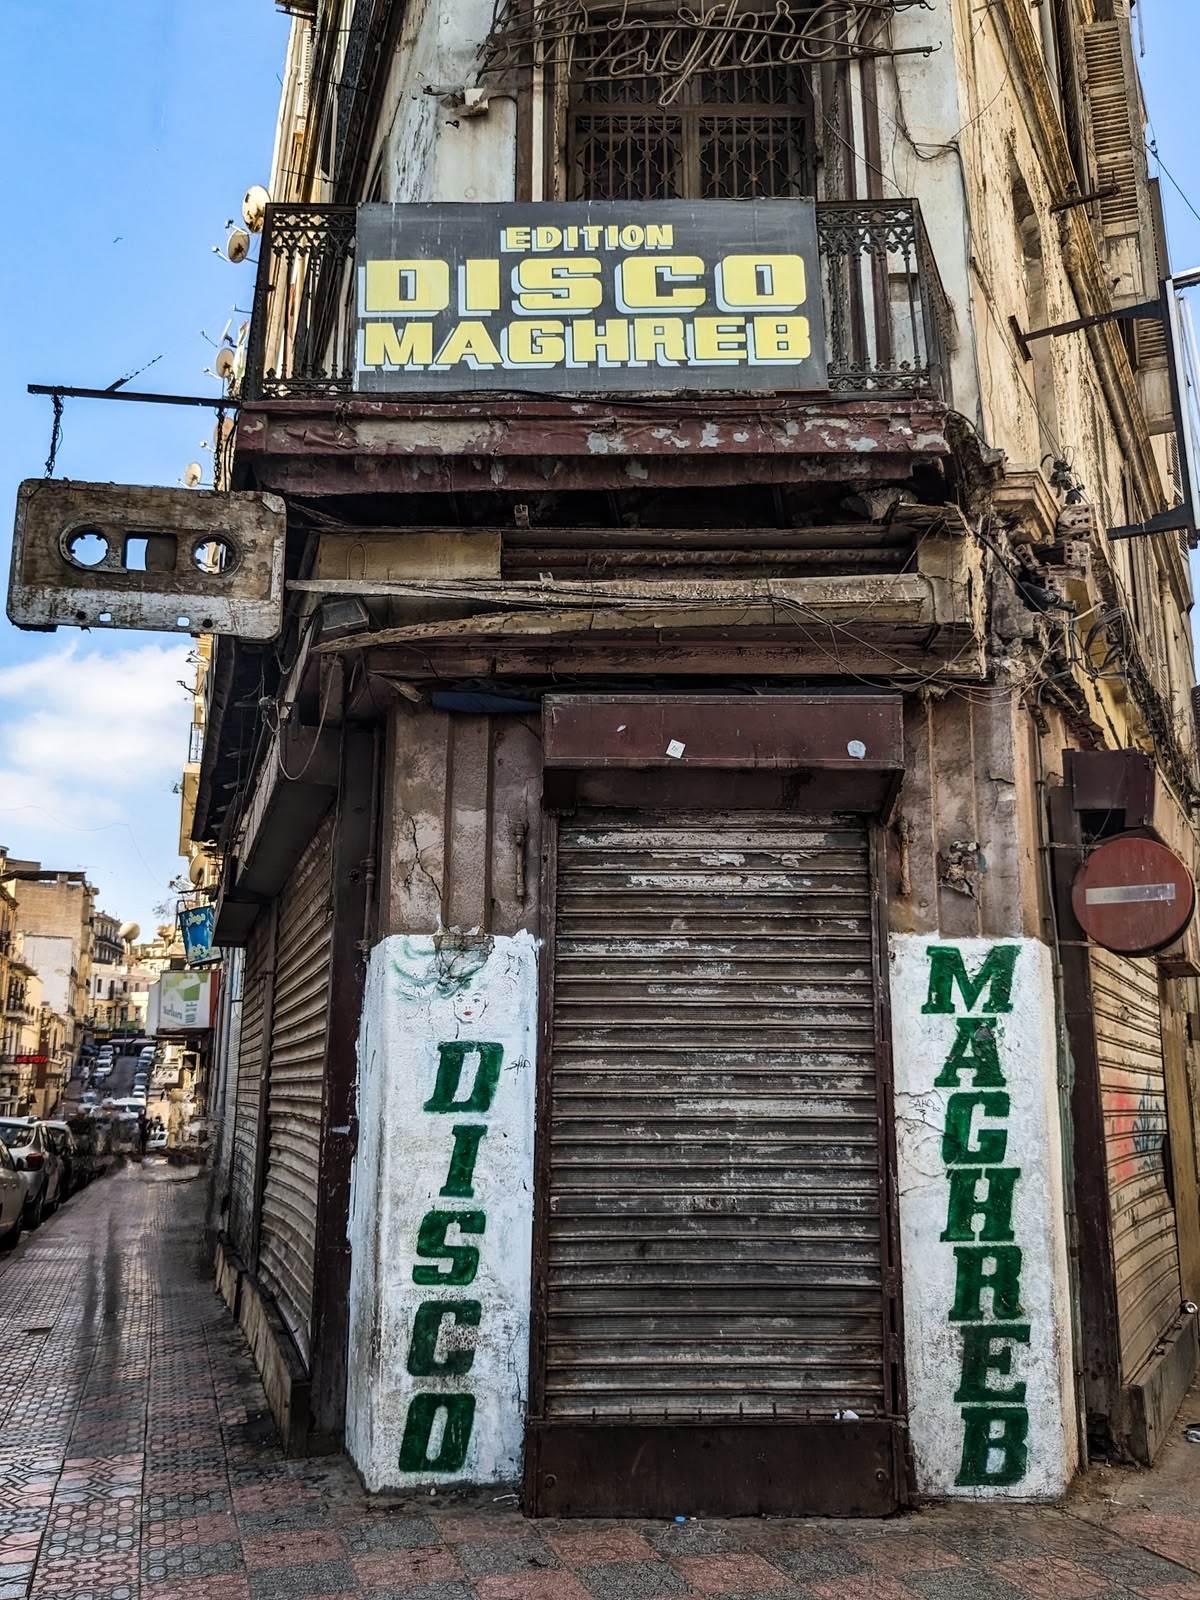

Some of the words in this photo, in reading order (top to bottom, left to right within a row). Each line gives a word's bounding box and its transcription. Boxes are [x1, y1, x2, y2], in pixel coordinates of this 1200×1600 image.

[501, 224, 674, 252] EDITION
[358, 255, 807, 317] DISCO
[358, 316, 811, 372] MAGHREB
[921, 945, 1031, 1487] MAGHREB
[400, 1041, 504, 1474] DISCO
